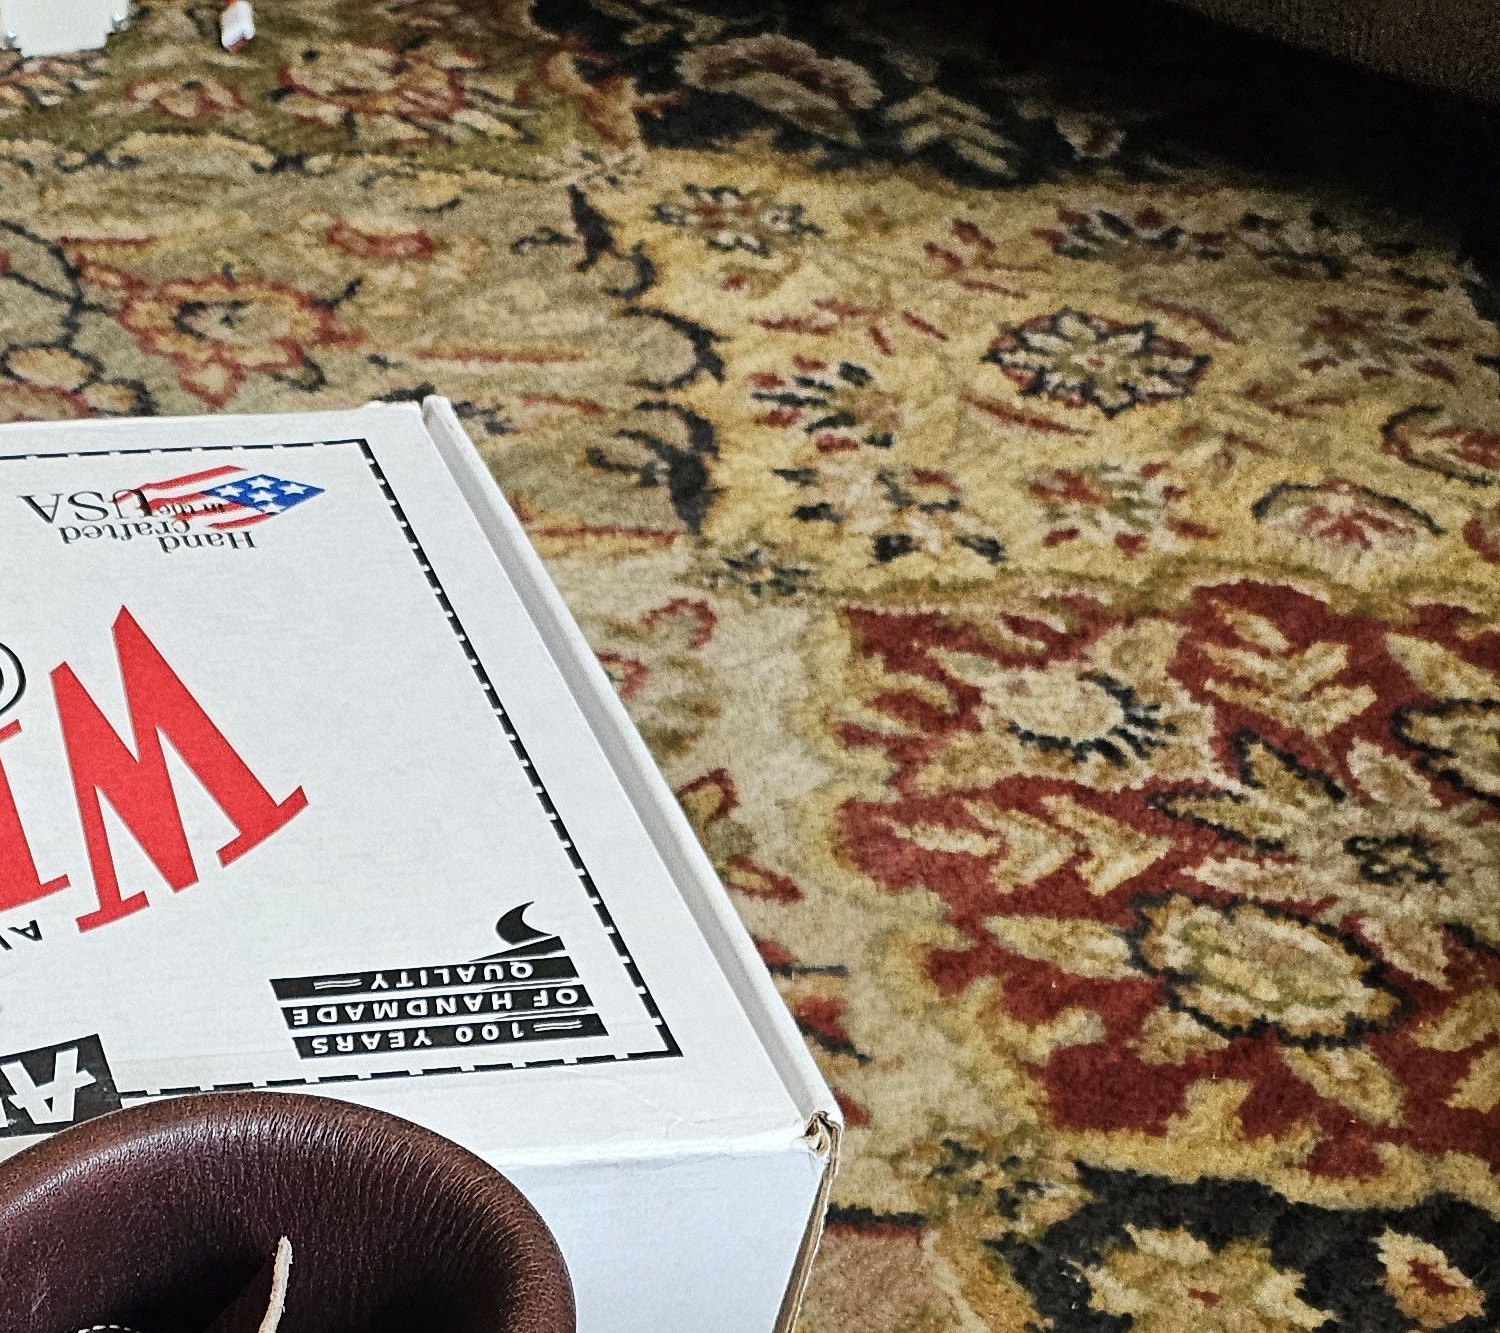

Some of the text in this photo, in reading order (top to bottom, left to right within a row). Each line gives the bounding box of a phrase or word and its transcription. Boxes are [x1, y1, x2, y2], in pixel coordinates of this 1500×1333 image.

[17, 488, 226, 524] in the USA
[58, 519, 191, 545] crafted
[158, 531, 258, 554] Hand
[370, 961, 534, 990] QUALITY
[293, 987, 579, 1026] OF HANDMADE
[312, 1022, 524, 1055] 100 YEARS
